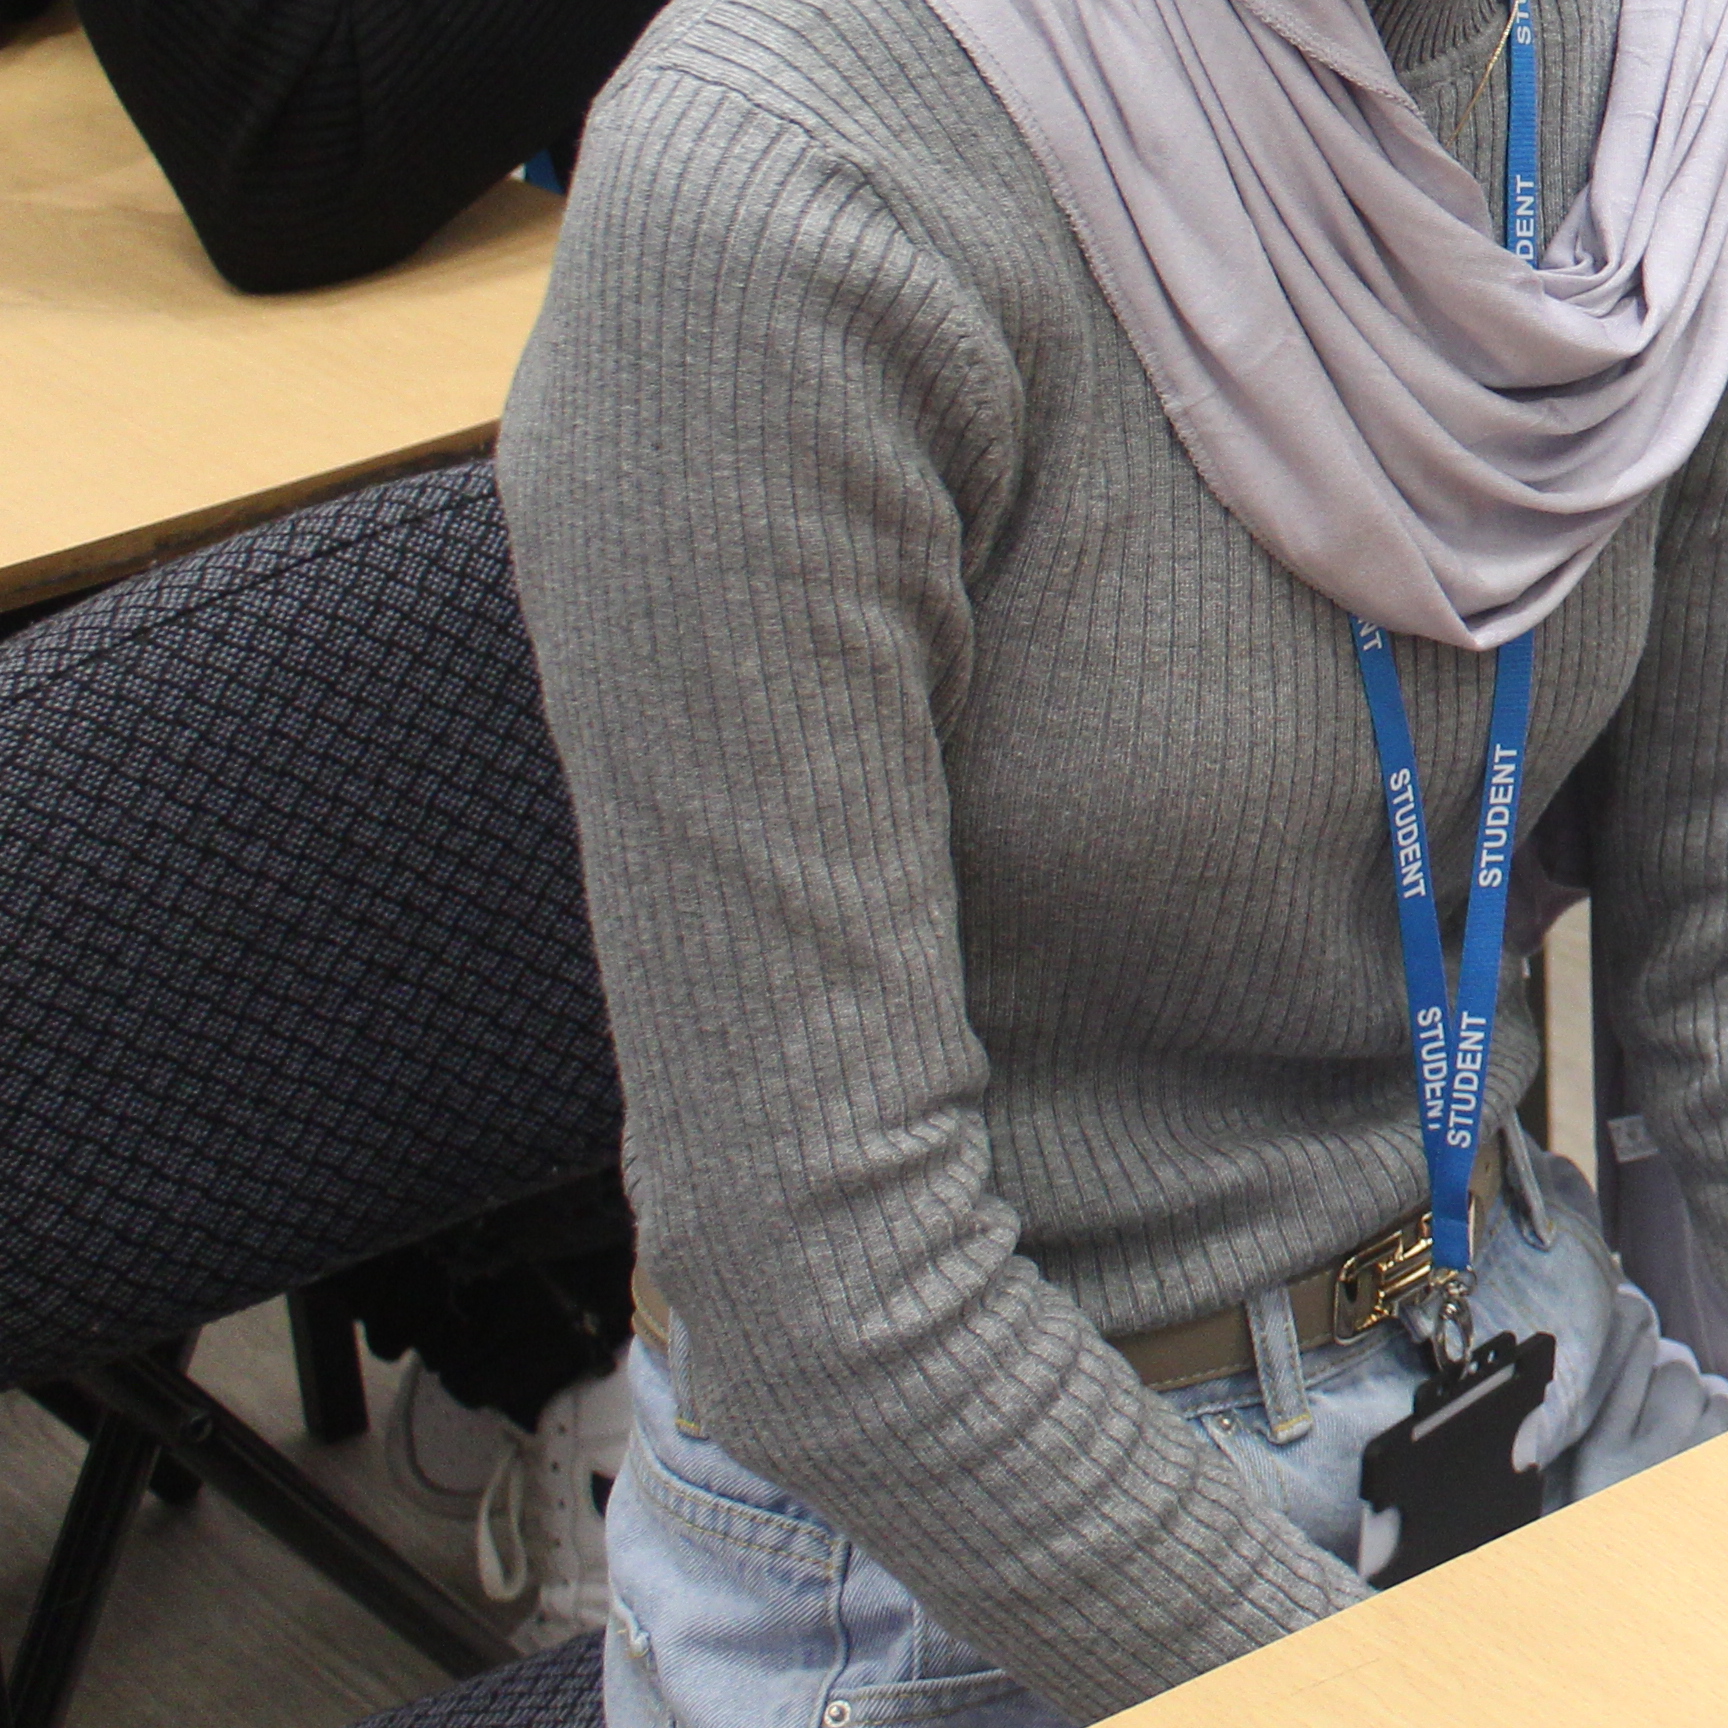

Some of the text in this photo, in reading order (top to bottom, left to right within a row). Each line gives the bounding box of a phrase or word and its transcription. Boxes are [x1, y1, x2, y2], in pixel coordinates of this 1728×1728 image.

[1515, 174, 1535, 261] DENT
[1389, 768, 1427, 900] STUDENT
[1477, 743, 1518, 889] STUDENT
[1446, 1009, 1487, 1149] STUDENT
